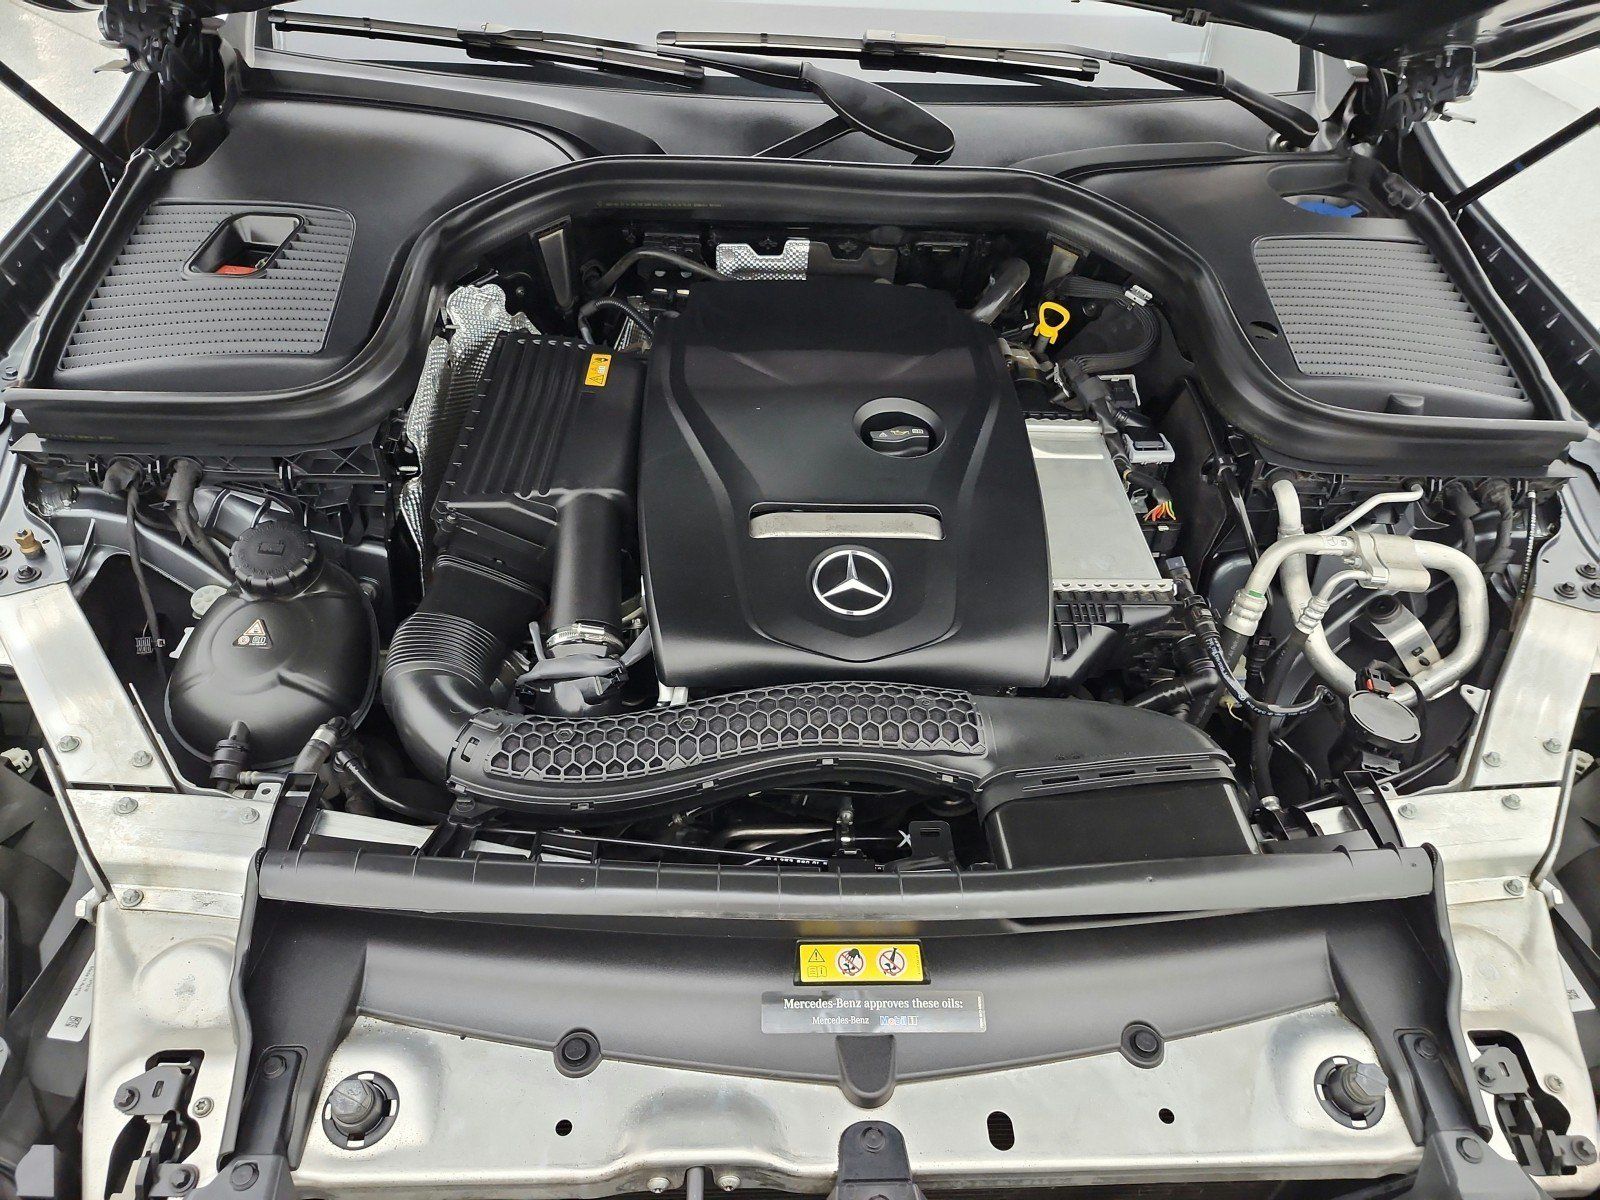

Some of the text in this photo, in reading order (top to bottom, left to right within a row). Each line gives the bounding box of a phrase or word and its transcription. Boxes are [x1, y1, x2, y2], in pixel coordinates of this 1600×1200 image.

[784, 998, 963, 1011] Mercedes-Benz approves these oils:
[812, 1016, 869, 1025] Mercedes-Benz
[880, 1016, 906, 1026] Mobil
